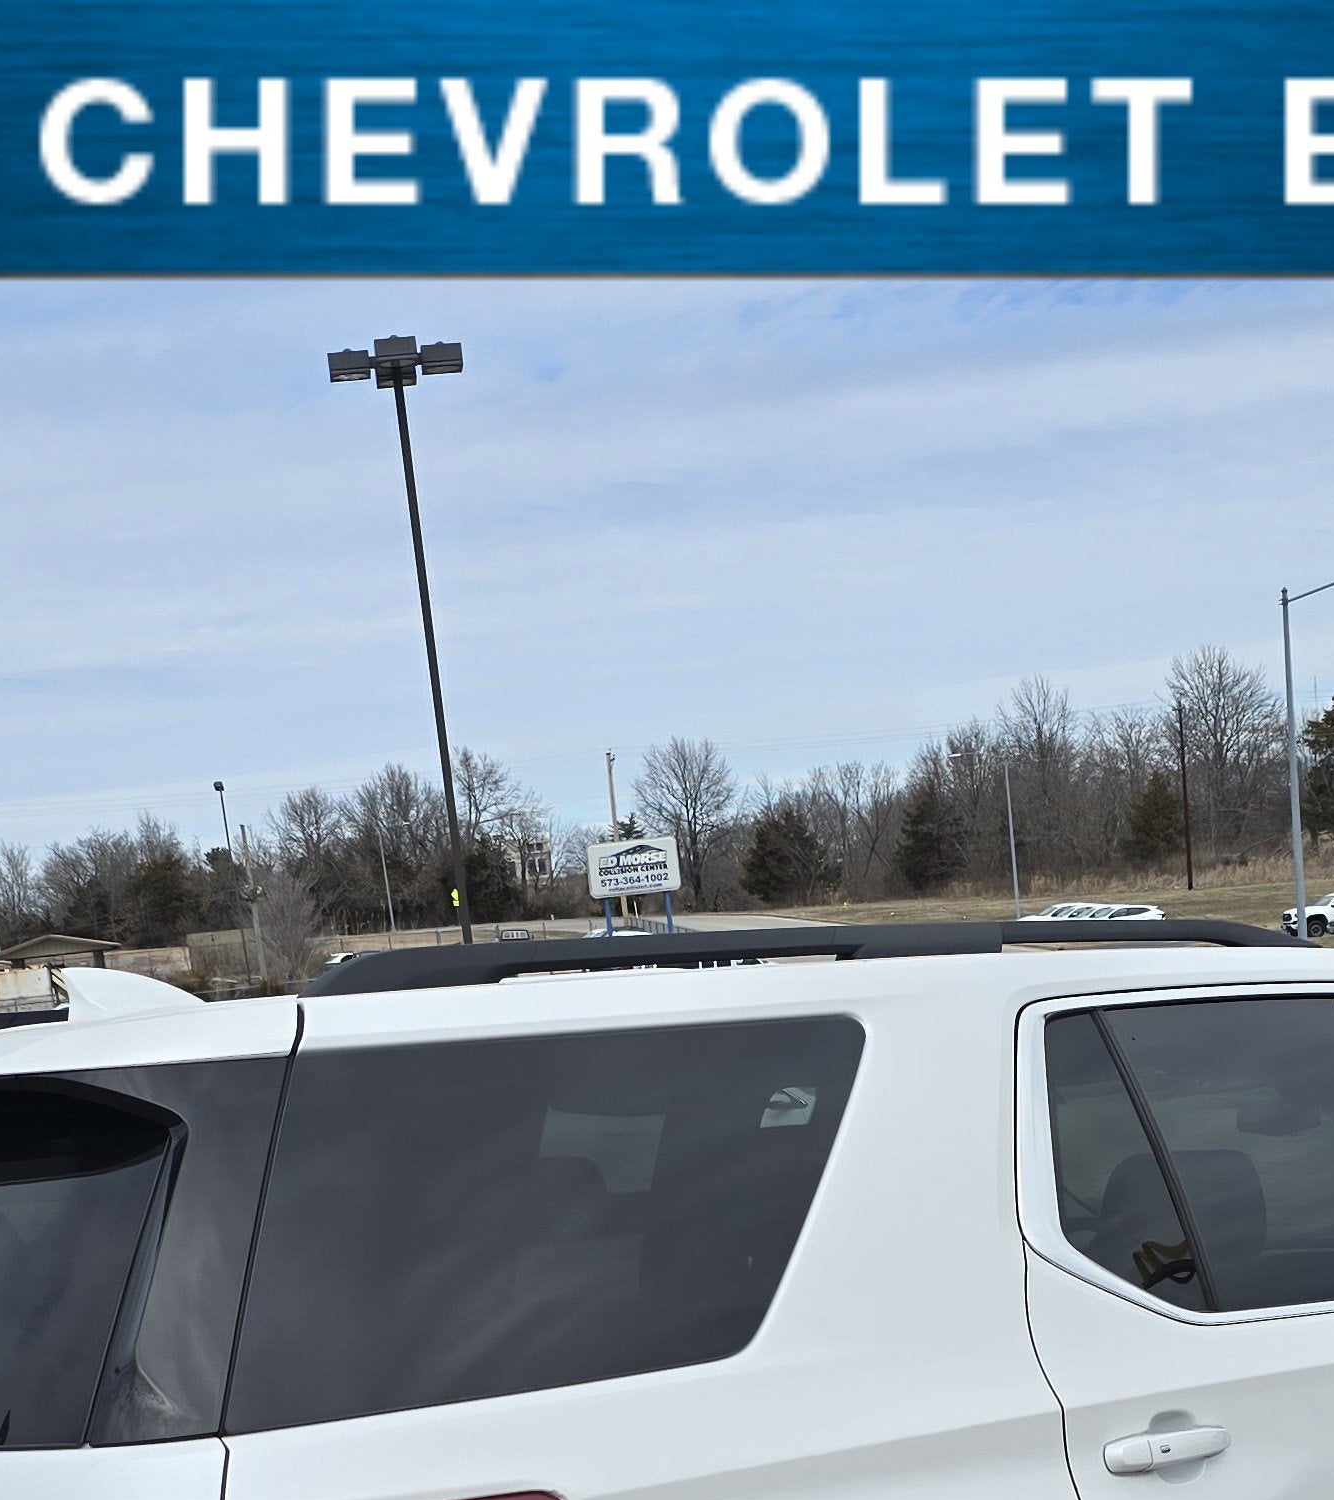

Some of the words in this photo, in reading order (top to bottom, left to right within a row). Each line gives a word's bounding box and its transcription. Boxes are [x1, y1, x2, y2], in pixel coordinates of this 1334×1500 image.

[599, 857, 618, 869] ED
[619, 850, 667, 867] MORSE
[600, 873, 670, 887] 573-364-1002
